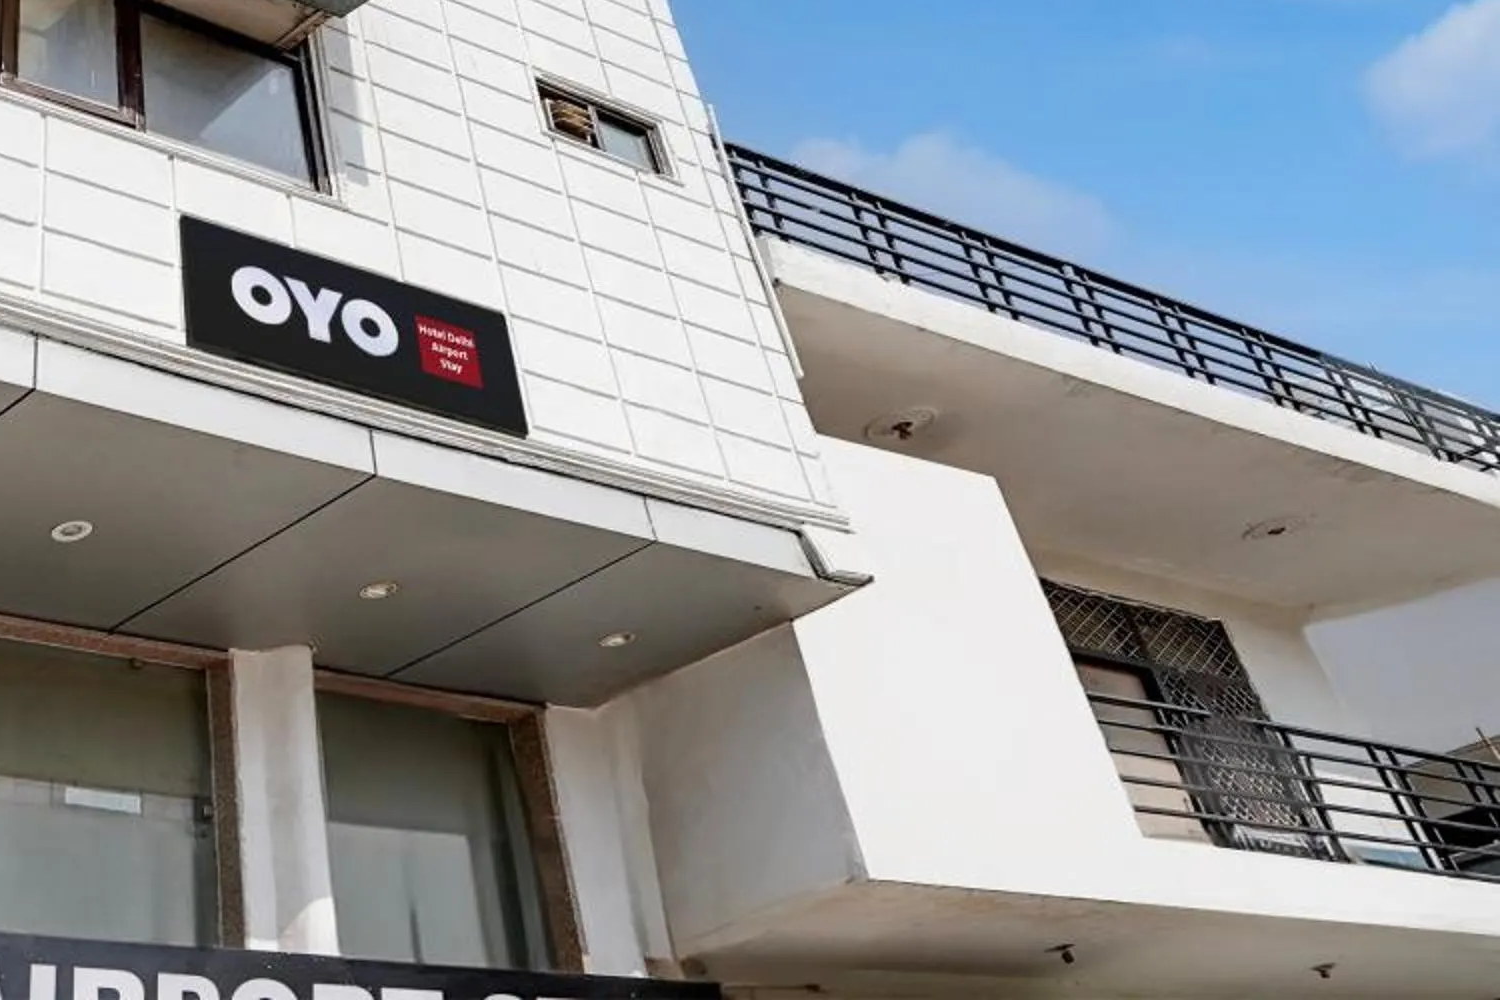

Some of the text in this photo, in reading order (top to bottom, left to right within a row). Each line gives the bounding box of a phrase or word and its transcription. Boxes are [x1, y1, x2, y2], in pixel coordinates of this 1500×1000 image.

[231, 265, 399, 358] OYO
[418, 323, 476, 348] Hotel Delhi
[431, 342, 469, 361] Airport
[440, 358, 463, 375] Stay
